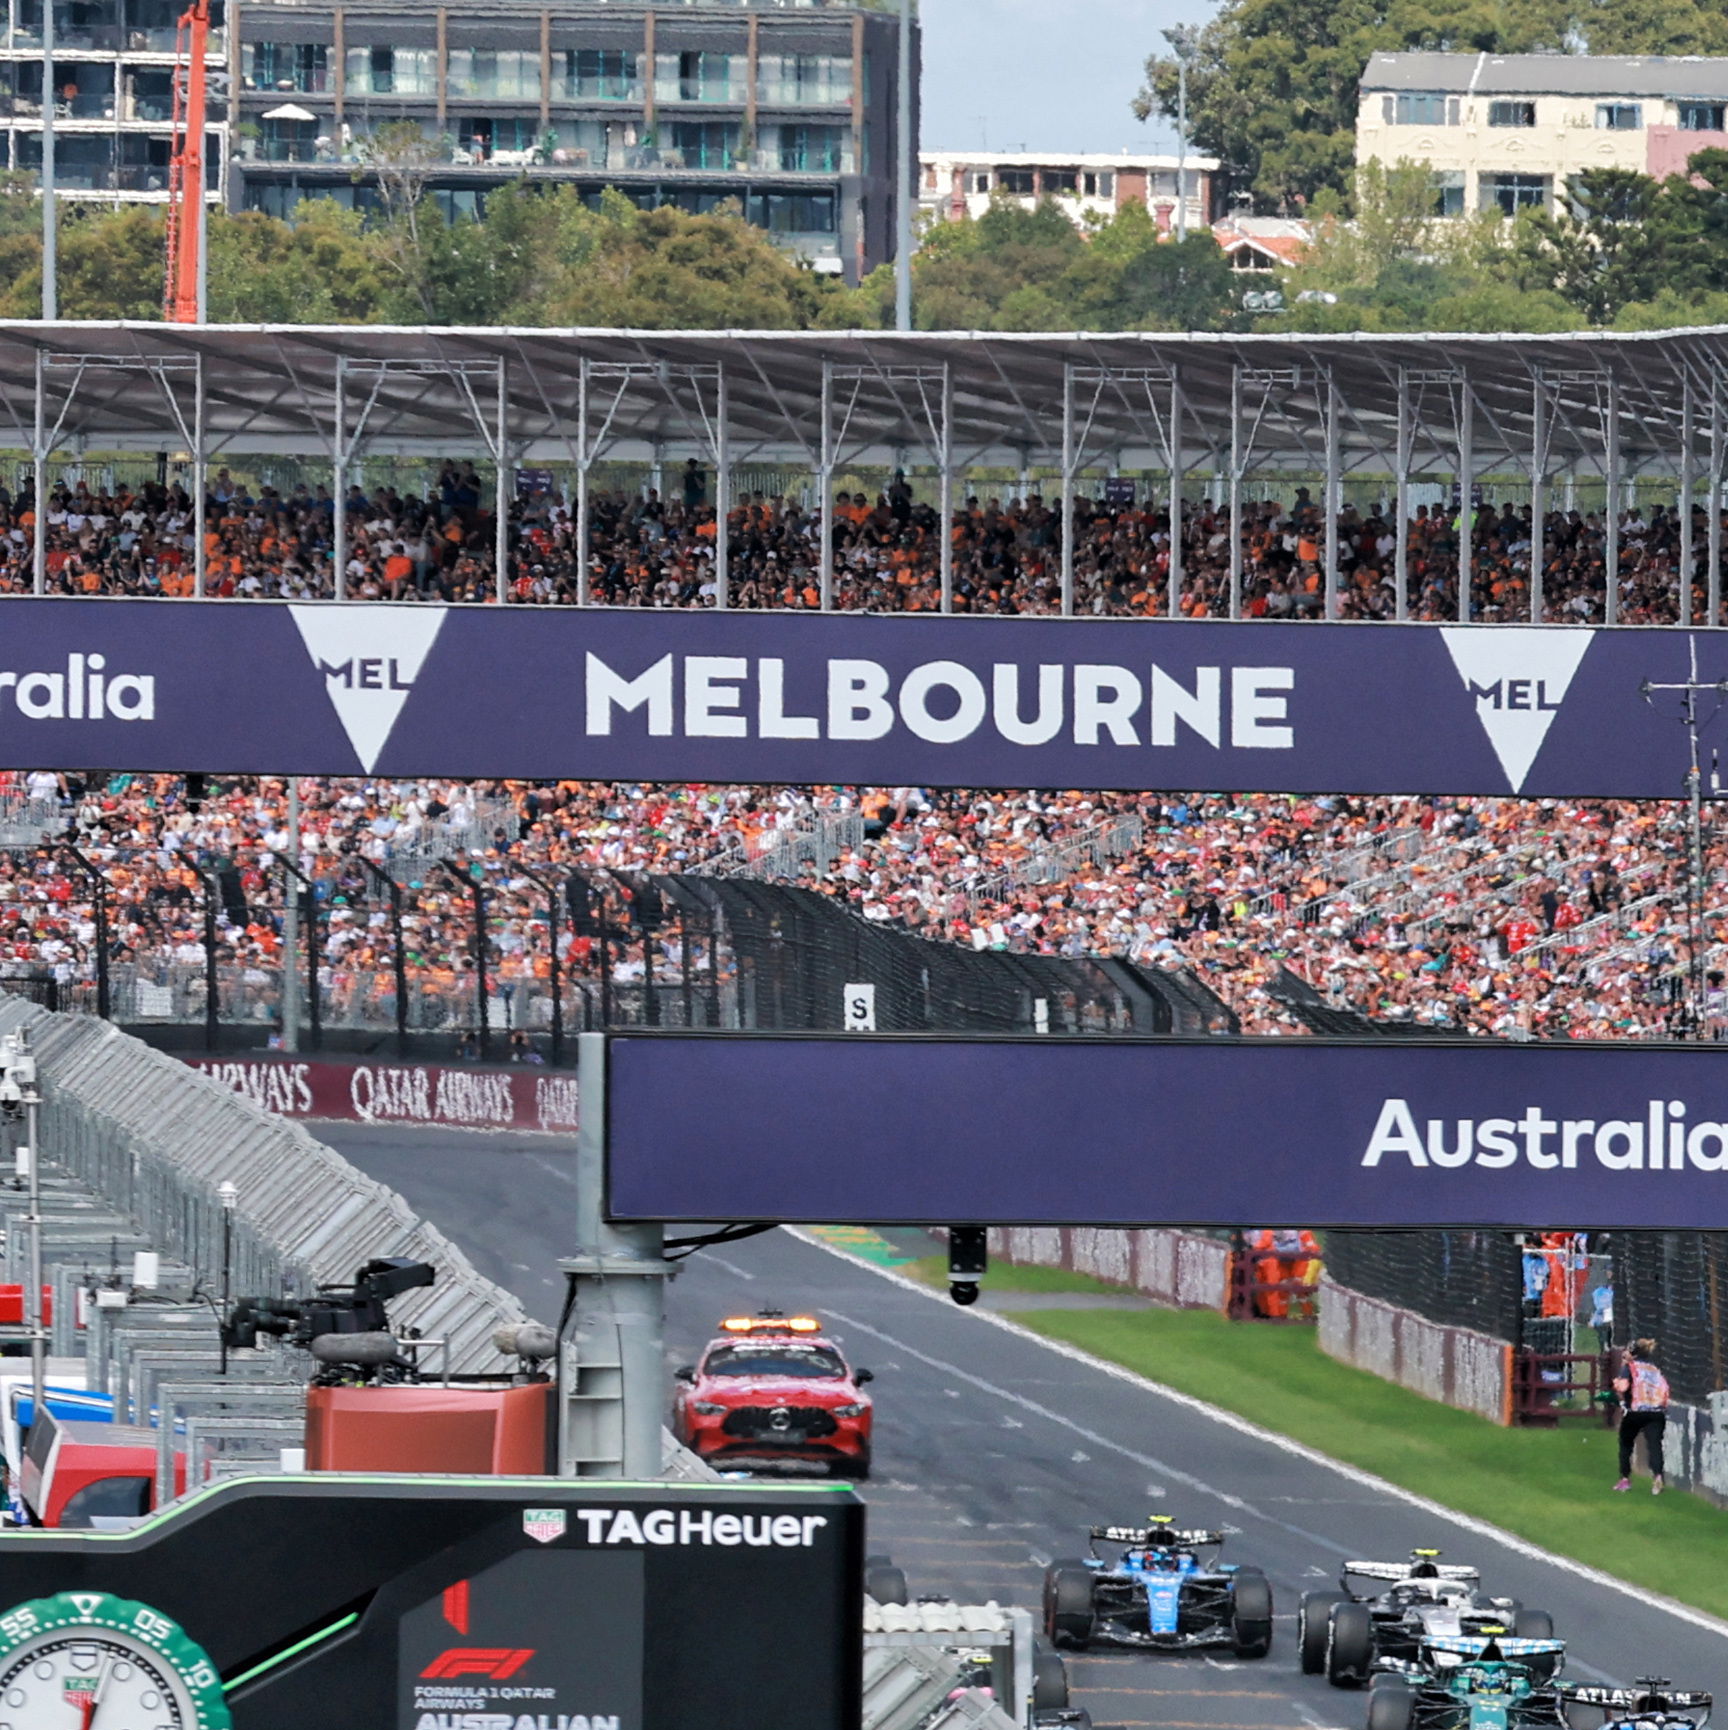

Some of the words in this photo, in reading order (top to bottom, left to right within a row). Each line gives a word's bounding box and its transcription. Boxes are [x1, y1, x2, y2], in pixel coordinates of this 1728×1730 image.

[318, 657, 410, 692] MEL
[586, 651, 1294, 749] MELBOURNE
[1467, 678, 1560, 712] MEL
[134, 1609, 174, 1640] 05
[189, 1659, 217, 1689] 10
[414, 1686, 487, 1698] FORMULA
[488, 1688, 499, 1698] 1
[500, 1688, 556, 1699] QATAR
[414, 1699, 486, 1710] AIRWAYS
